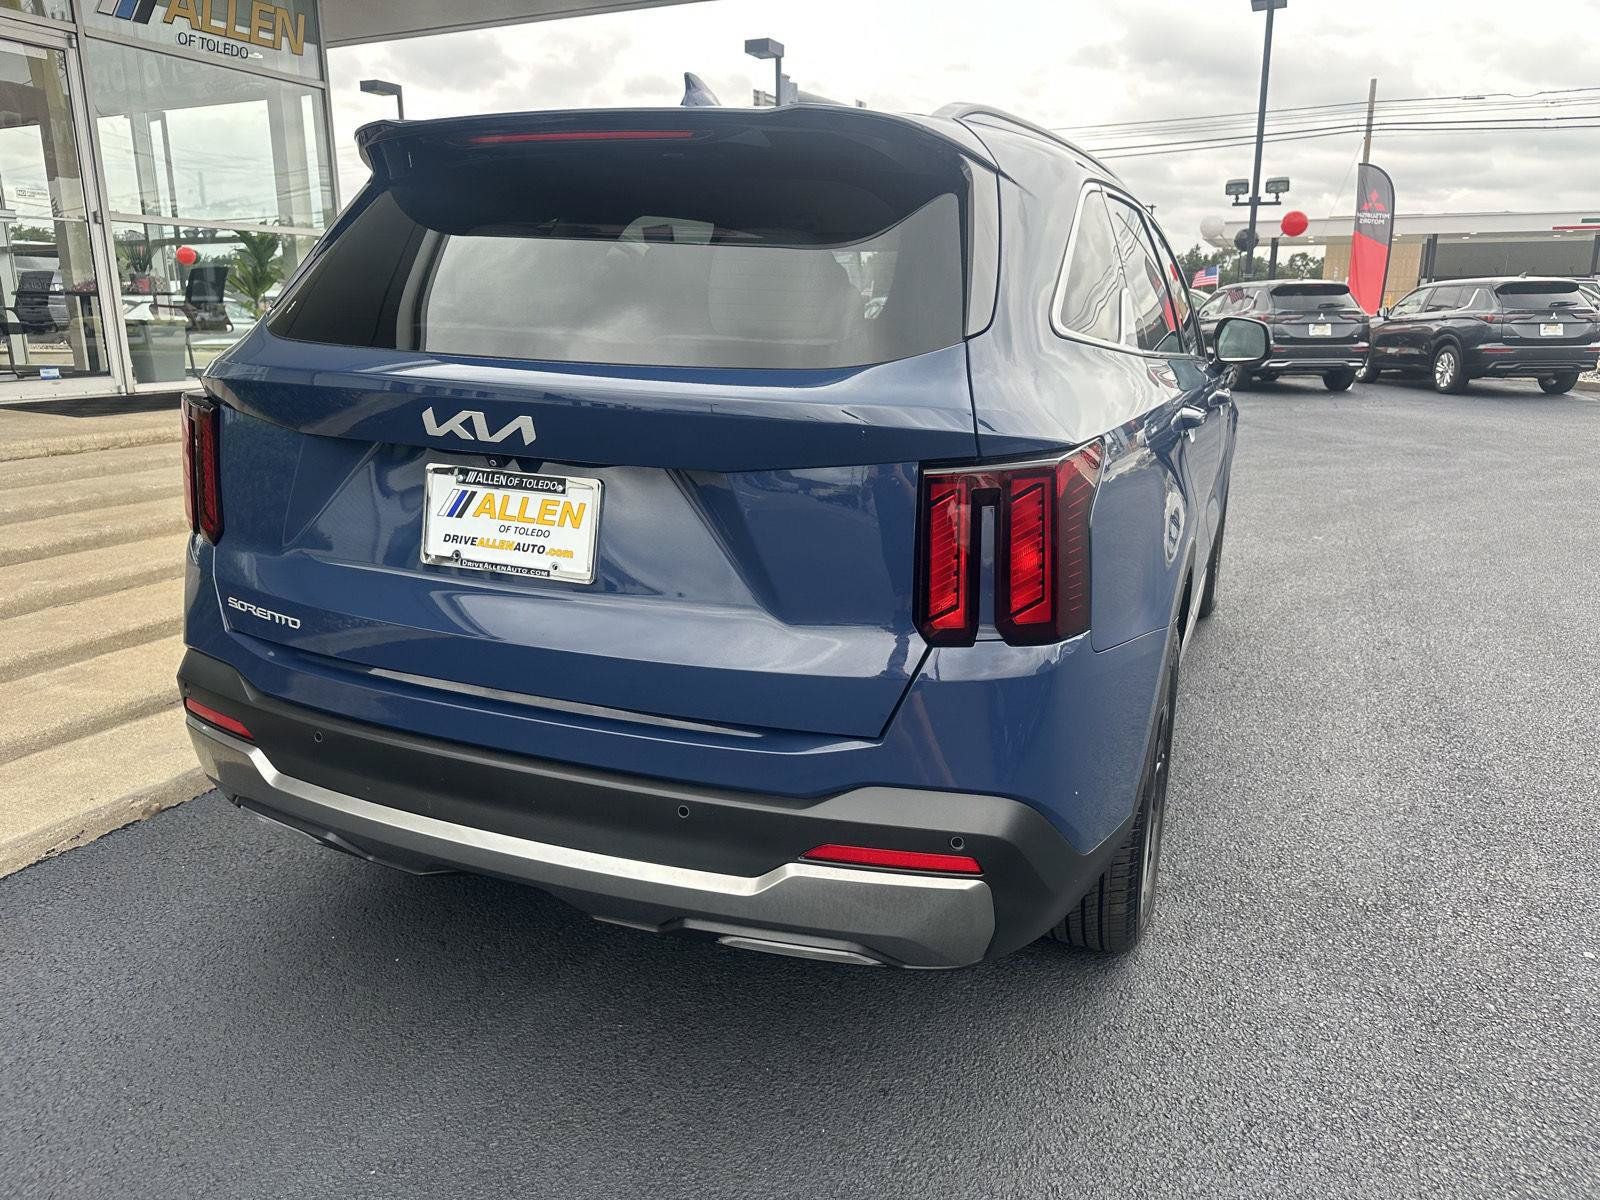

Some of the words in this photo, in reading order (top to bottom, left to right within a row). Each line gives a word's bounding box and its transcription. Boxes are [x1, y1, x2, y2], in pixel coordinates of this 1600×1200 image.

[163, 0, 305, 57] ALLEN
[178, 31, 197, 47] OF
[199, 36, 249, 59] TOLEDO
[422, 407, 536, 446] KIA
[475, 472, 507, 487] ALLEN
[507, 477, 520, 487] OF
[521, 478, 558, 491] TOLEDO
[472, 493, 586, 529] ALLEN
[498, 524, 511, 534] OF
[513, 526, 551, 539] TOLEDO
[227, 596, 301, 630] SORENTO
